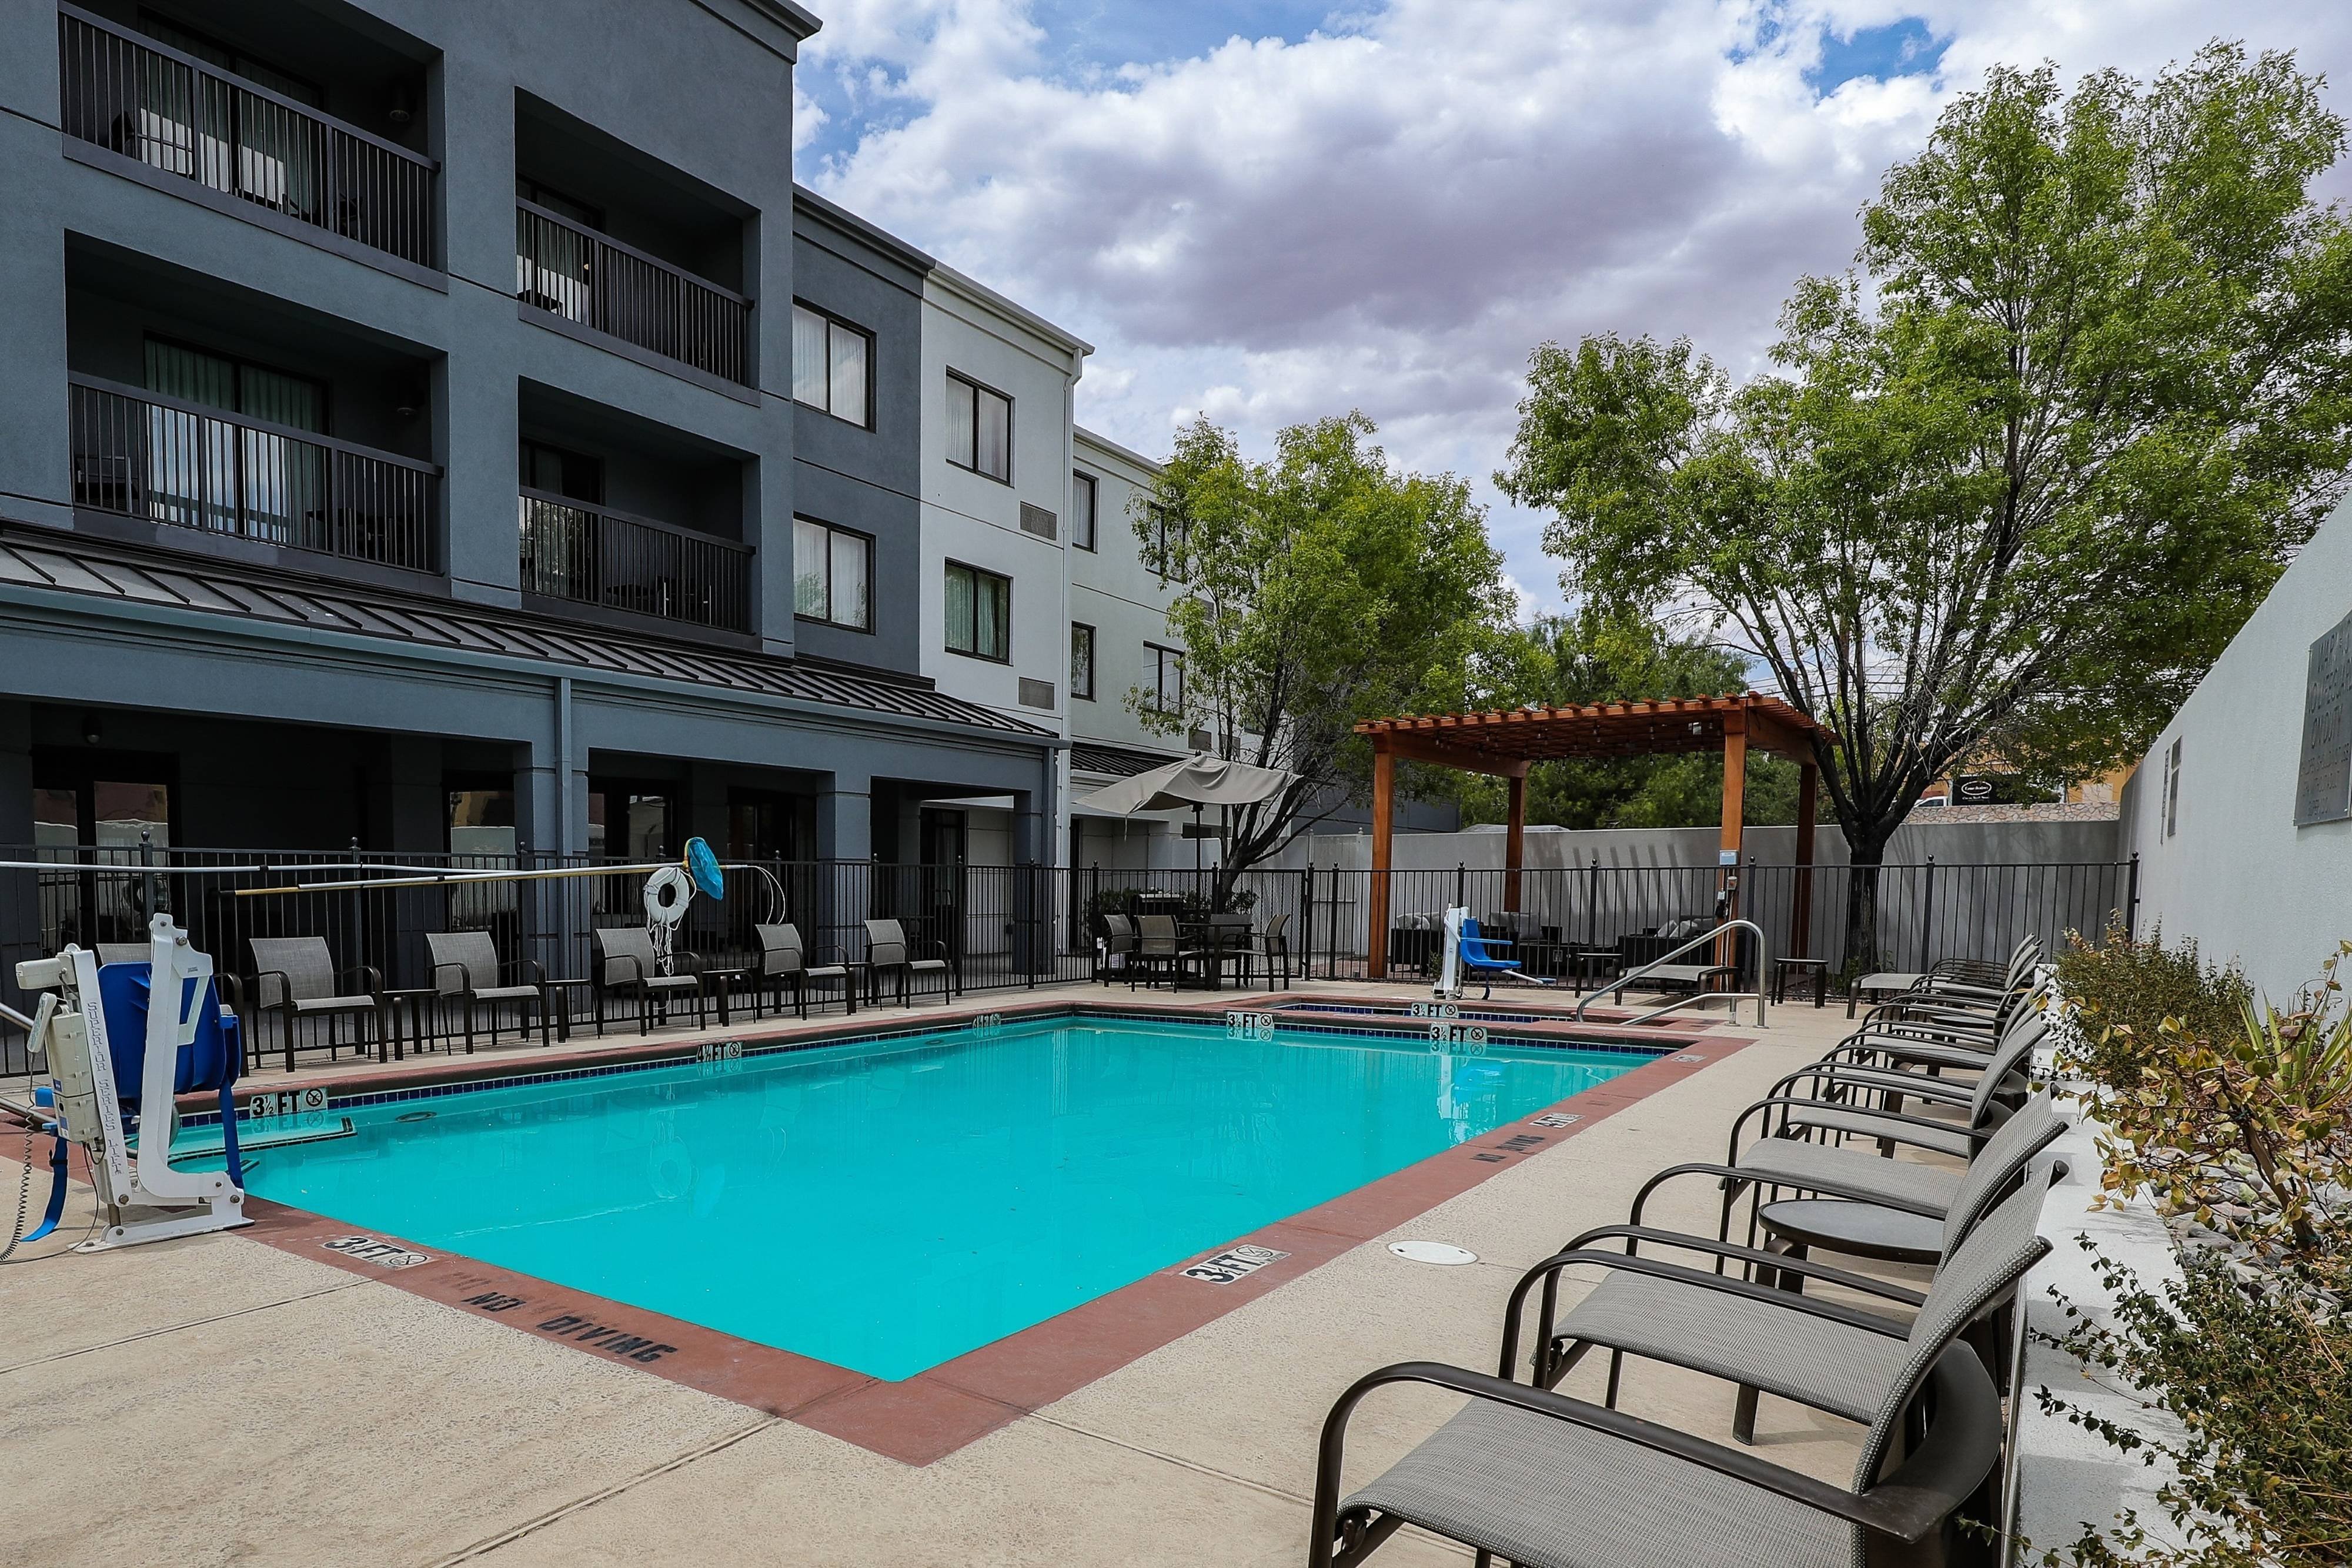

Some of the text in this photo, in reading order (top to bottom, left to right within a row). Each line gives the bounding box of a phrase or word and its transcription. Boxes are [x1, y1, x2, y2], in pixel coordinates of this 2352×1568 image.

[87, 1002, 122, 1174] SUPERIOR SERIES LIFT
[460, 1292, 678, 1362] NO DIVING
